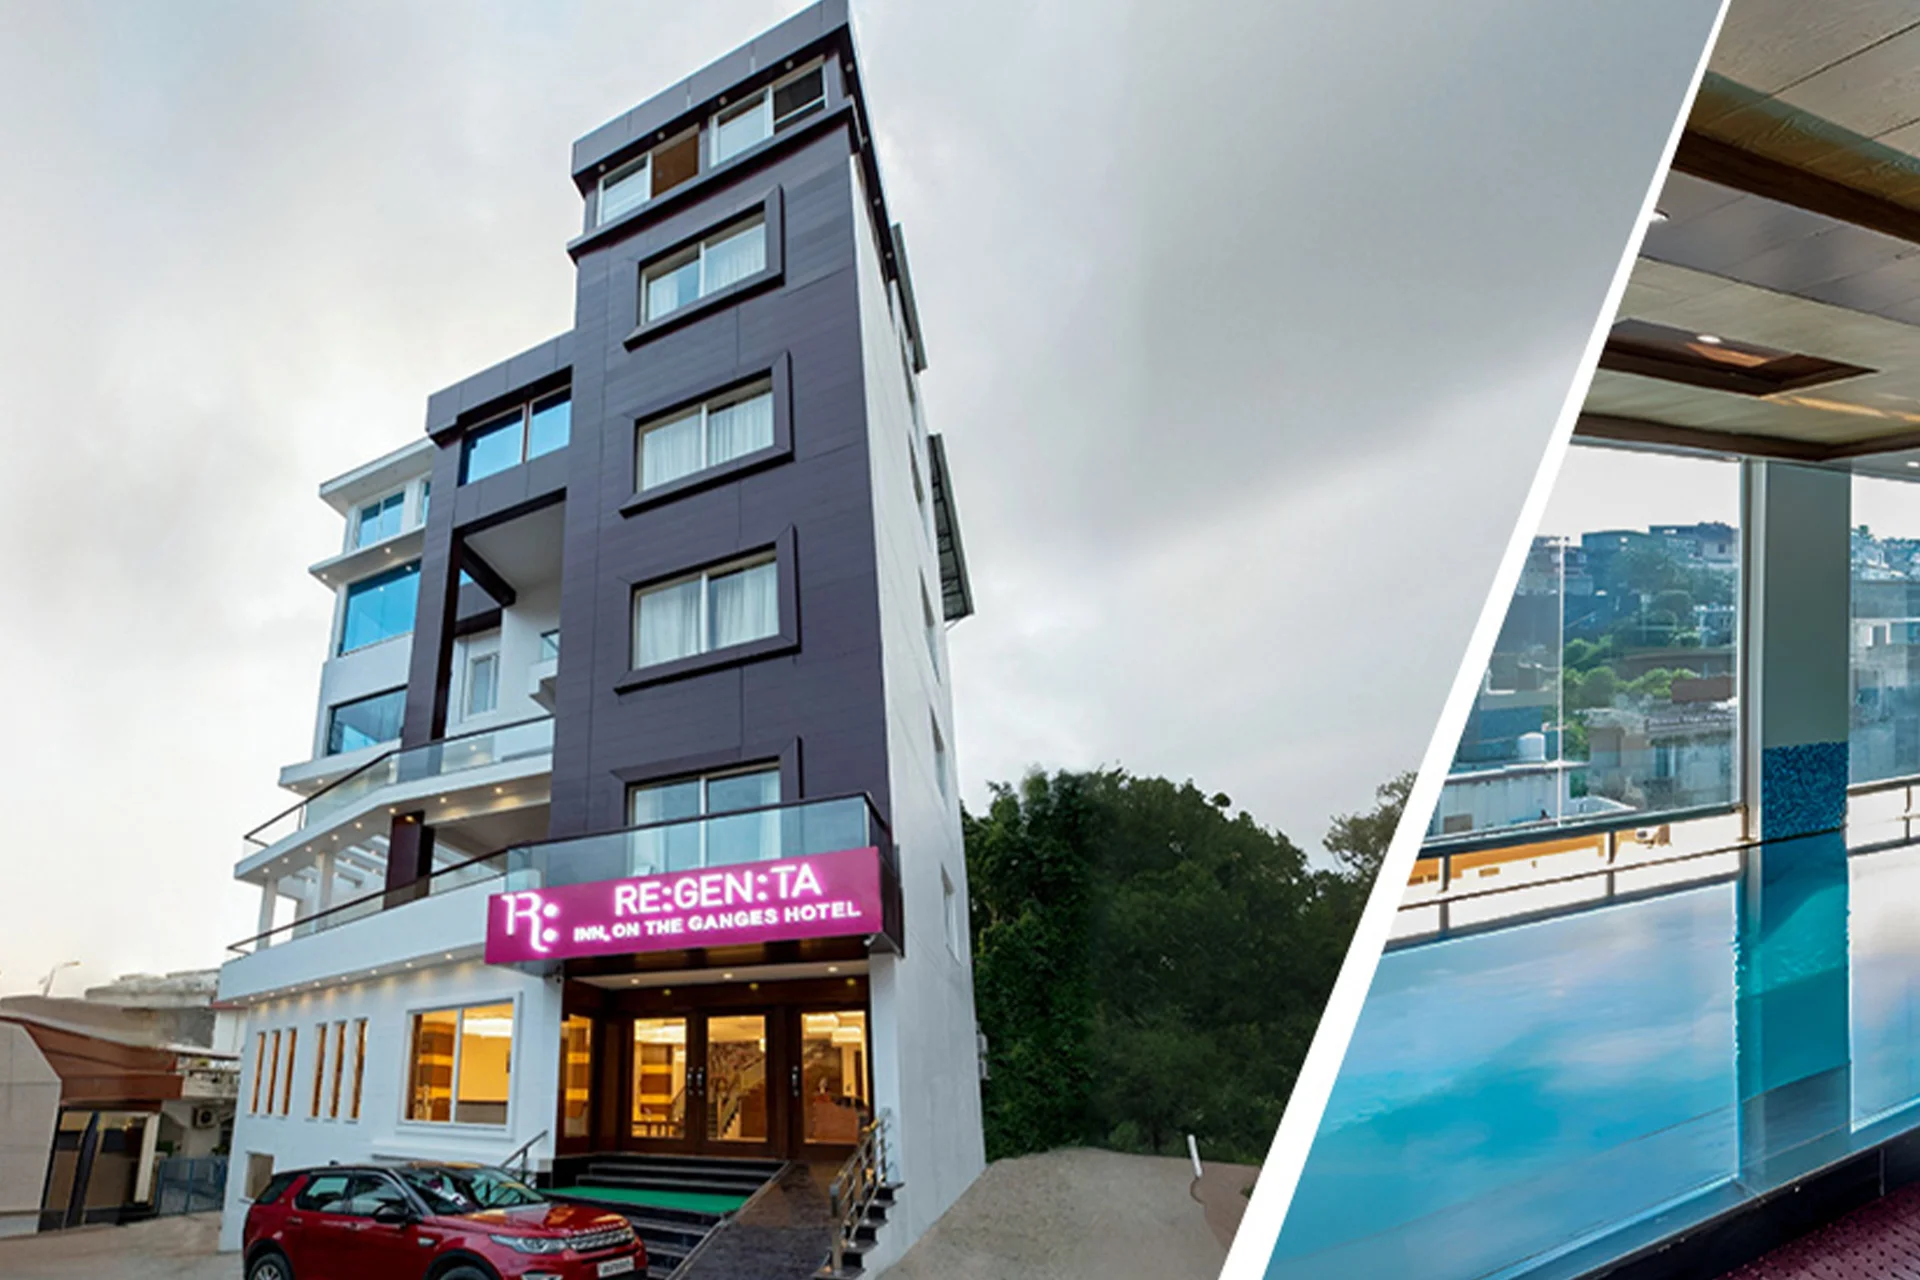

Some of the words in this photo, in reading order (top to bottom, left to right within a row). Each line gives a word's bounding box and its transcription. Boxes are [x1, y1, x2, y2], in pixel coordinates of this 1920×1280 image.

[614, 862, 822, 917] RE:GEN:TA
[612, 922, 640, 938] ON
[645, 918, 683, 936] THE
[688, 908, 778, 931] GANGES
[784, 901, 862, 923] HOTEL
